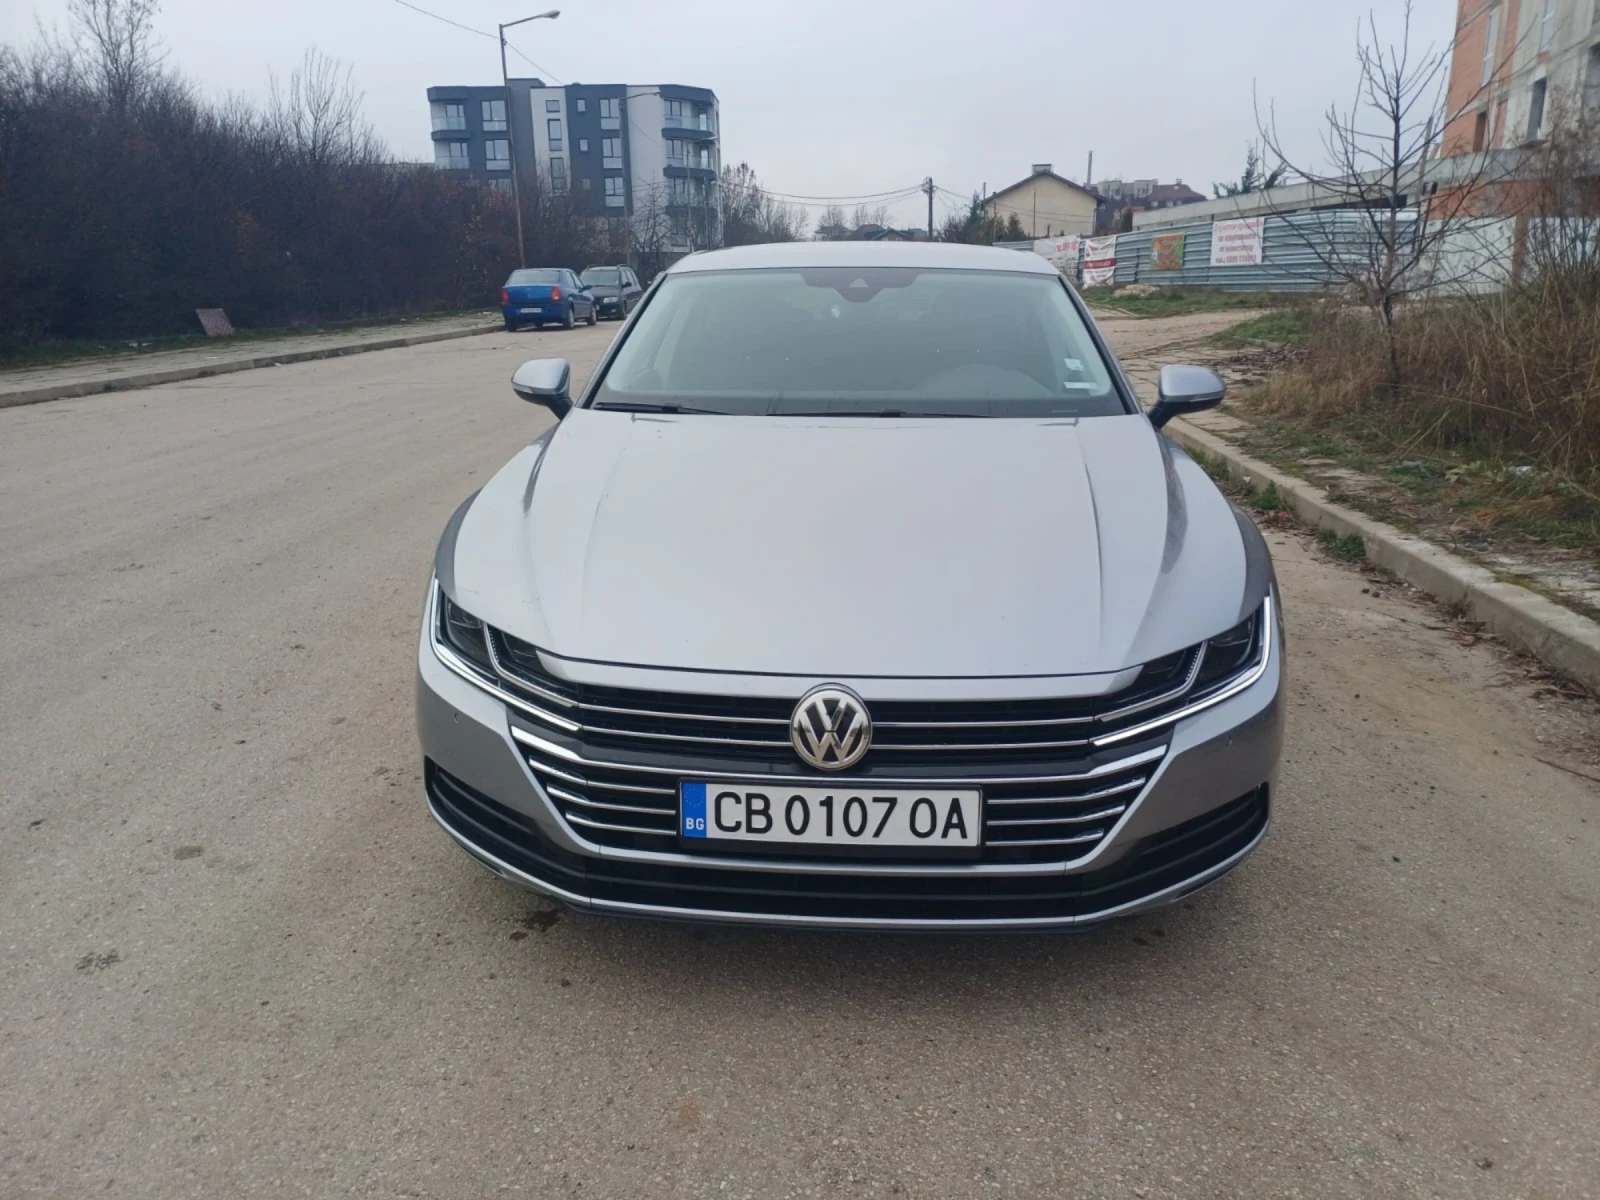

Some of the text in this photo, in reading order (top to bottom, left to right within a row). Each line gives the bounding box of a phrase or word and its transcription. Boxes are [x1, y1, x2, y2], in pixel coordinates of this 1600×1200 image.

[793, 690, 868, 768] VW
[685, 817, 705, 831] BG
[714, 791, 968, 839] CB 0107 OA
